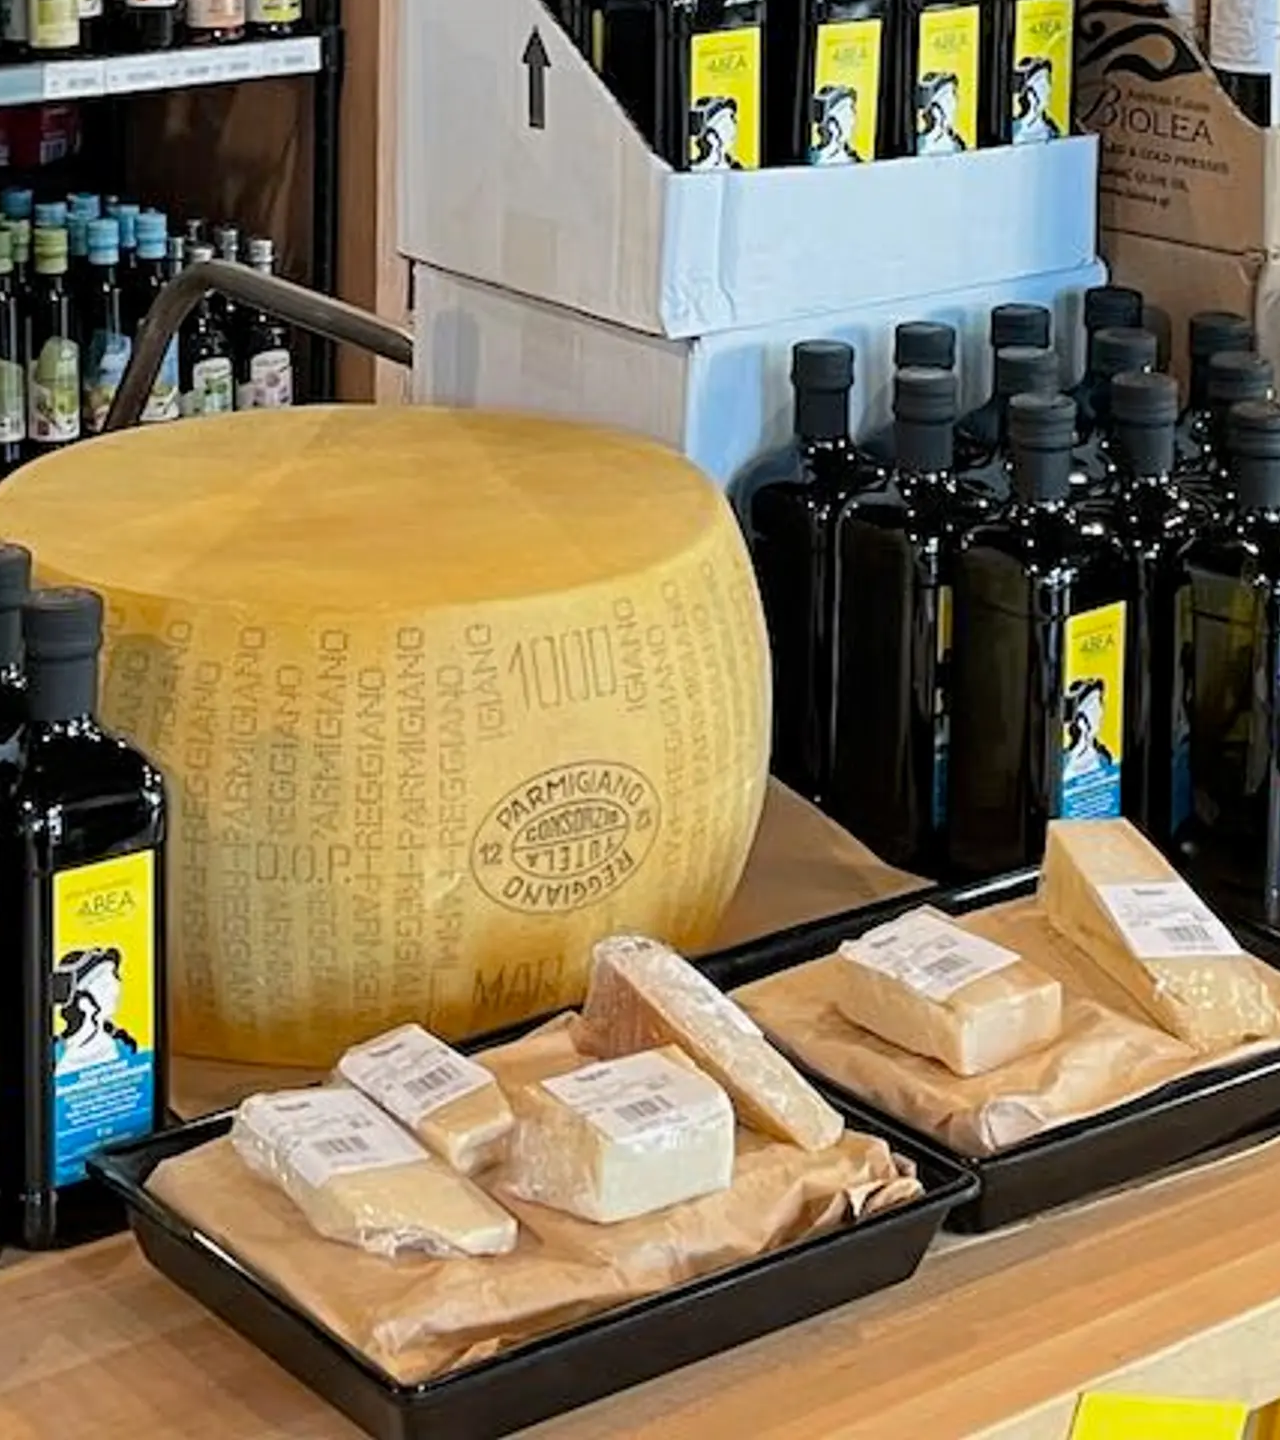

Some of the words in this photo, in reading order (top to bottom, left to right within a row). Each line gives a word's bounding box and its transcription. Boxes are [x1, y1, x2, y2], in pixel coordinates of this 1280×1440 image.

[508, 624, 618, 712] 1000
[396, 626, 426, 850] PARMIGIANO
[495, 769, 646, 832] PARMIGIANO
[77, 890, 137, 917] ABEA
[501, 847, 637, 908] REGGIANO
